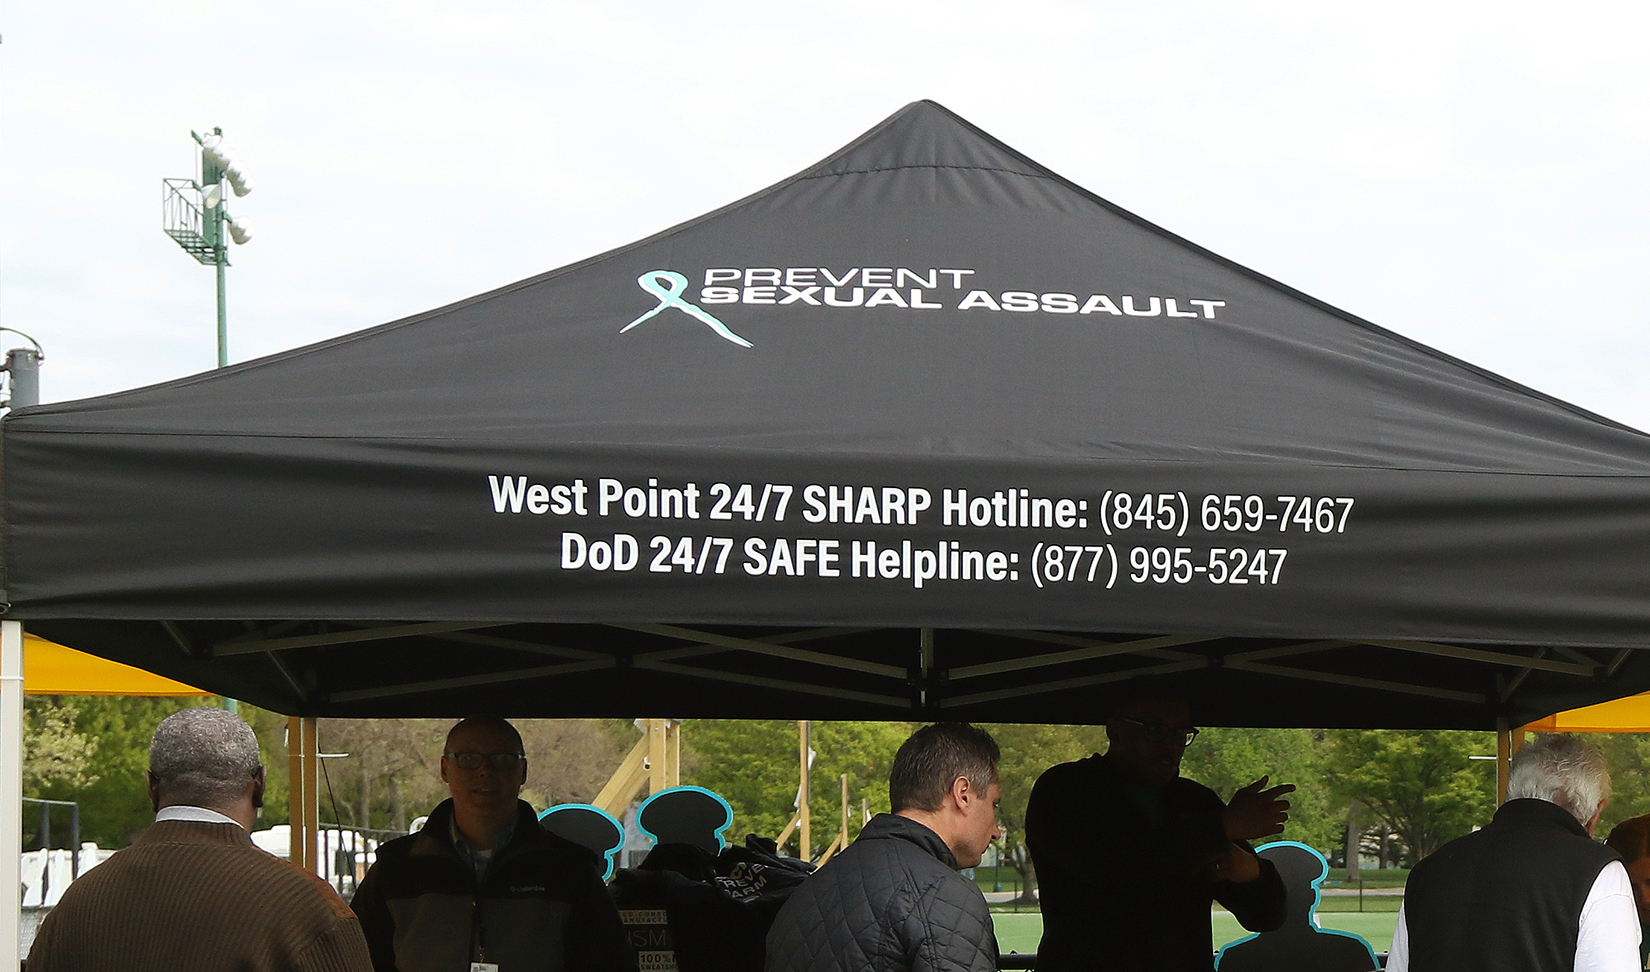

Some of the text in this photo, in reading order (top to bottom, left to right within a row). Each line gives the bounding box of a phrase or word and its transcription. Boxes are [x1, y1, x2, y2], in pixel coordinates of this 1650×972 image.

[704, 267, 976, 290] PREVENT
[698, 285, 1227, 320] SEXUAL ASSAULT
[488, 475, 1355, 537] West Point 24/7 SHARP Hotline: (845) 659-7467
[561, 532, 1289, 589] DoD 24/7 SAFE Helpline: (877) 995-5247
